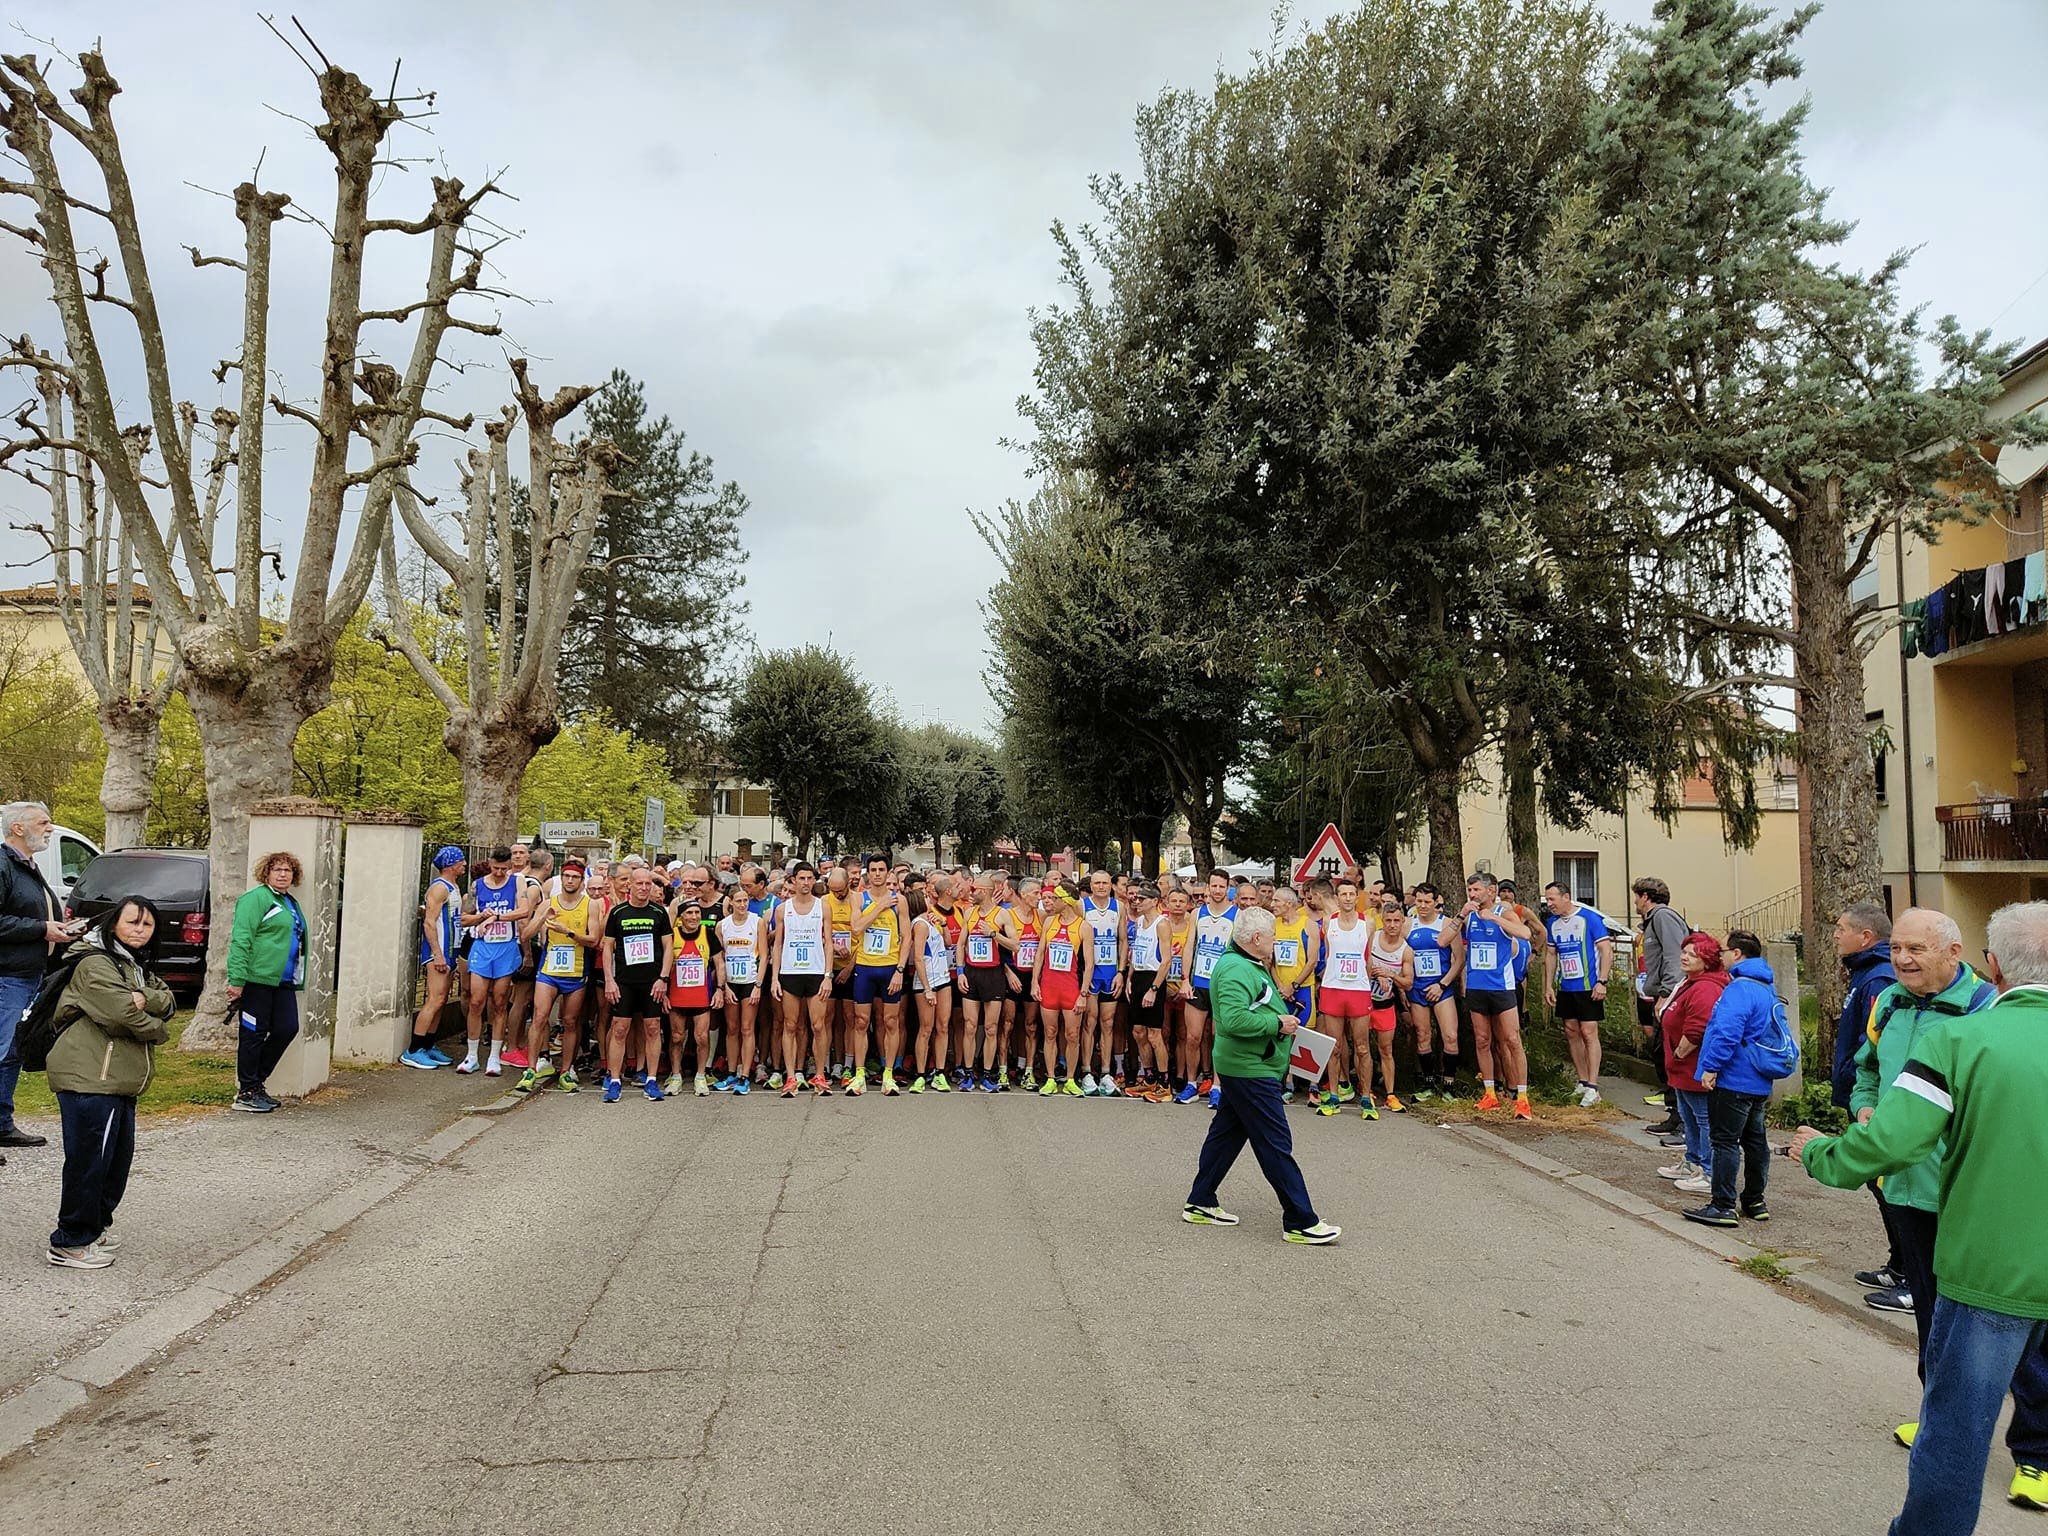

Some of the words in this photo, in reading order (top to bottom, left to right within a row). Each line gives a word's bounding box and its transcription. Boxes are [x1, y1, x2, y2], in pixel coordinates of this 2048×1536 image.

[489, 922, 507, 935] 205
[871, 934, 884, 948] 73
[630, 941, 649, 957] 236
[796, 948, 808, 961] 60
[973, 942, 988, 955] 195
[1100, 946, 1111, 958] 94
[1280, 946, 1291, 959] 25
[556, 951, 568, 965] 86
[1053, 950, 1068, 964] 173
[1421, 956, 1434, 969] 35
[1479, 949, 1488, 963] 81
[681, 966, 700, 980] 255
[731, 961, 747, 976] 176
[1340, 960, 1358, 973] 250
